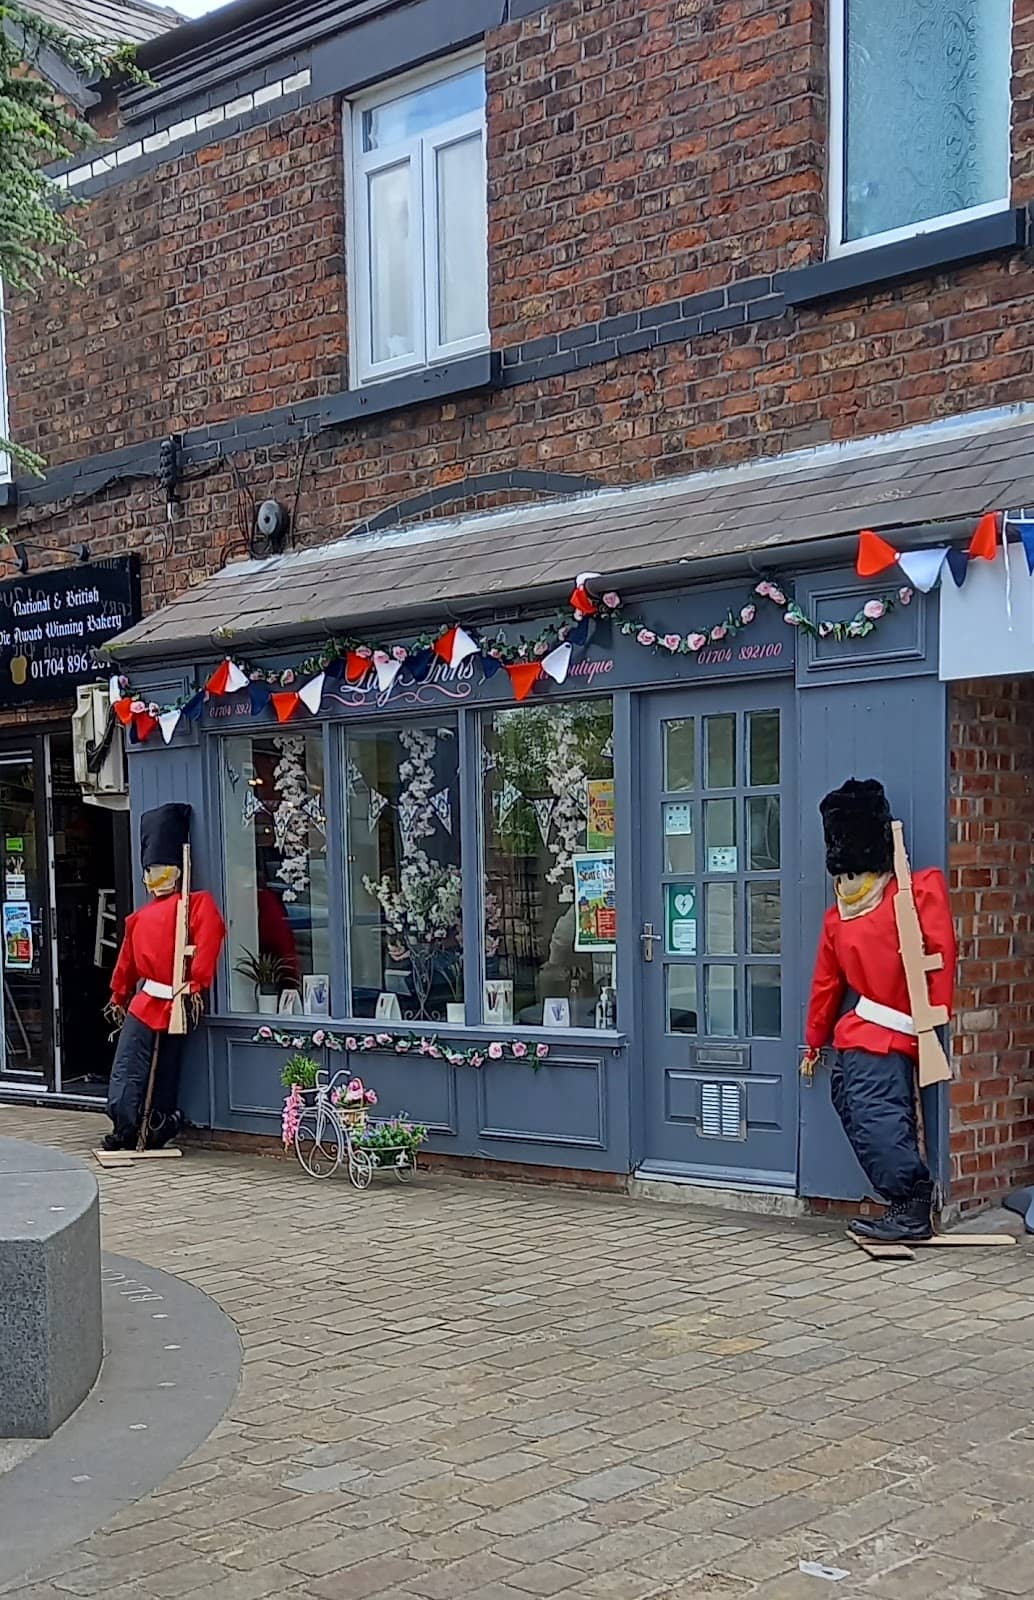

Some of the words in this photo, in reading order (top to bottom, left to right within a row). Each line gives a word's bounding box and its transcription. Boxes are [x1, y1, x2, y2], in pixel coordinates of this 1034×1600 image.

[13, 596, 51, 616] National
[53, 592, 62, 609] &
[66, 586, 99, 608] British
[13, 625, 42, 644] Award
[45, 618, 84, 637] Winning
[87, 614, 122, 633] Bakery
[31, 657, 64, 679] 01704
[67, 652, 88, 674] 896
[697, 648, 733, 665] 01704
[738, 641, 783, 661] 892100
[569, 658, 614, 685] utique
